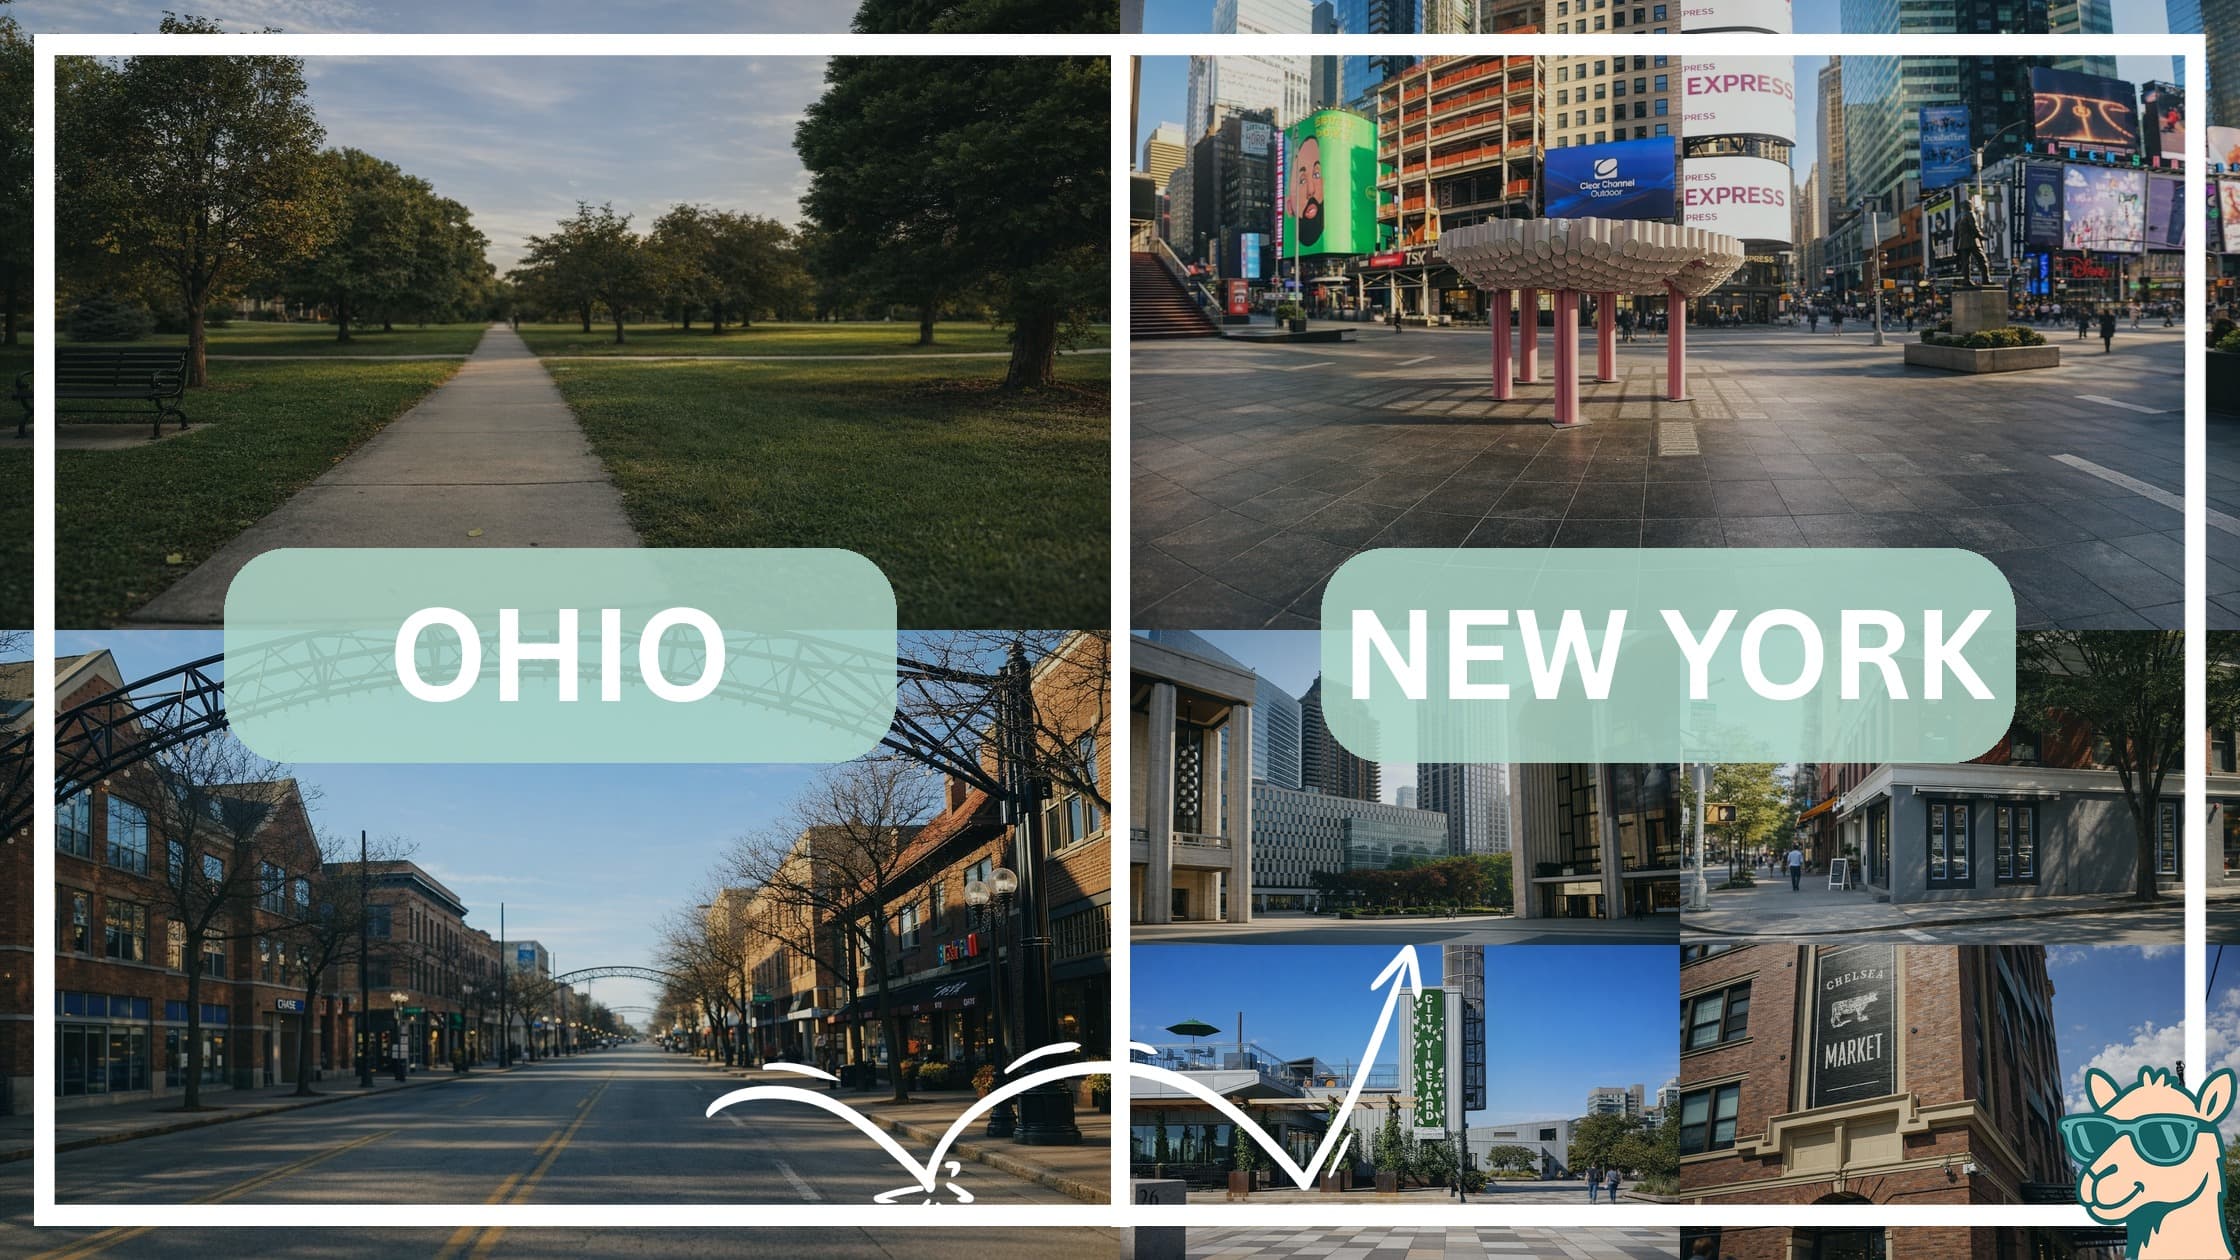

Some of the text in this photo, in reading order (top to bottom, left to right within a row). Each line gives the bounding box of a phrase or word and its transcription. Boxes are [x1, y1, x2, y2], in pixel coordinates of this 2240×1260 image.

[1687, 74, 1793, 100] EXPRESS
[1580, 178, 1635, 190] Clear Channel
[1591, 189, 1623, 198] Outdoor
[1685, 186, 1785, 207] EXPRESS
[1406, 251, 1426, 265] TSX
[1826, 969, 1884, 990] CHELSEA
[278, 999, 296, 1010] CHASE
[1424, 994, 1434, 1120] CITY VINEYARD
[1825, 1033, 1883, 1069] MARKET
